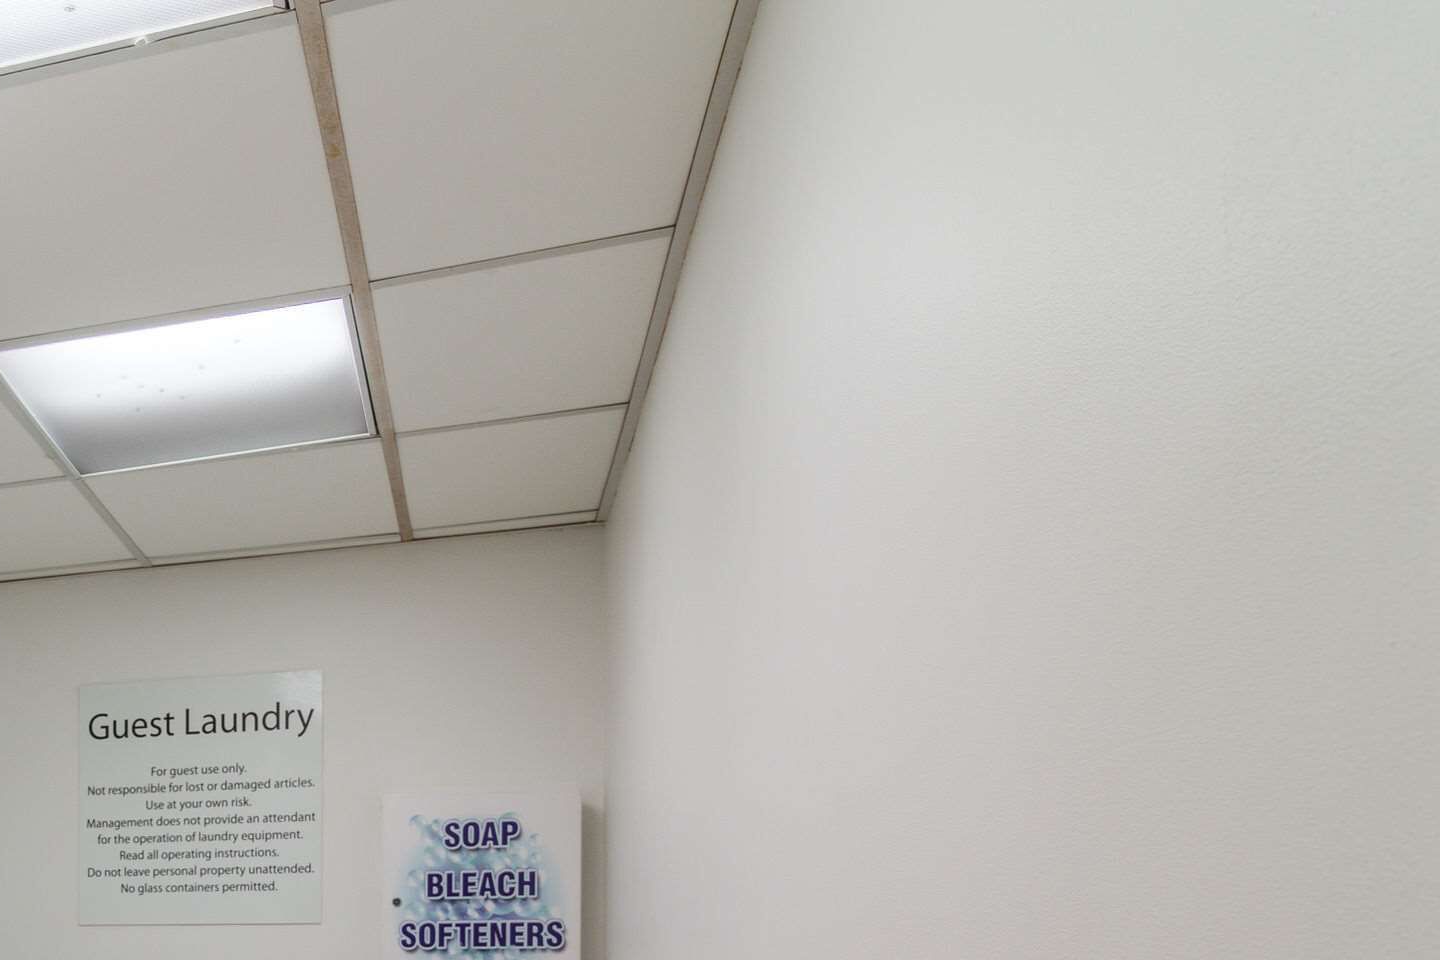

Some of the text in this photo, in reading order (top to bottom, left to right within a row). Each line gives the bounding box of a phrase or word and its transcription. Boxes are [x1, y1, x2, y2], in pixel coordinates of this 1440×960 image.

[88, 701, 314, 740] Guest Laundry
[151, 762, 247, 778] For guest use only.
[87, 776, 315, 798] Not responsible for lost or damaged articles.
[145, 796, 252, 811] Use at your own risk.
[86, 811, 315, 831] Management does not provide an attendant
[97, 830, 303, 845] for the operation of laundry equipment.
[444, 819, 521, 849] SOAP
[119, 848, 279, 861] Read all operating instructions.
[87, 863, 315, 878] Do not leave personal property unattended.
[120, 880, 279, 895] No glass containers permitted.
[426, 870, 537, 899] BLEACH
[400, 920, 565, 949] SOFTENERS
